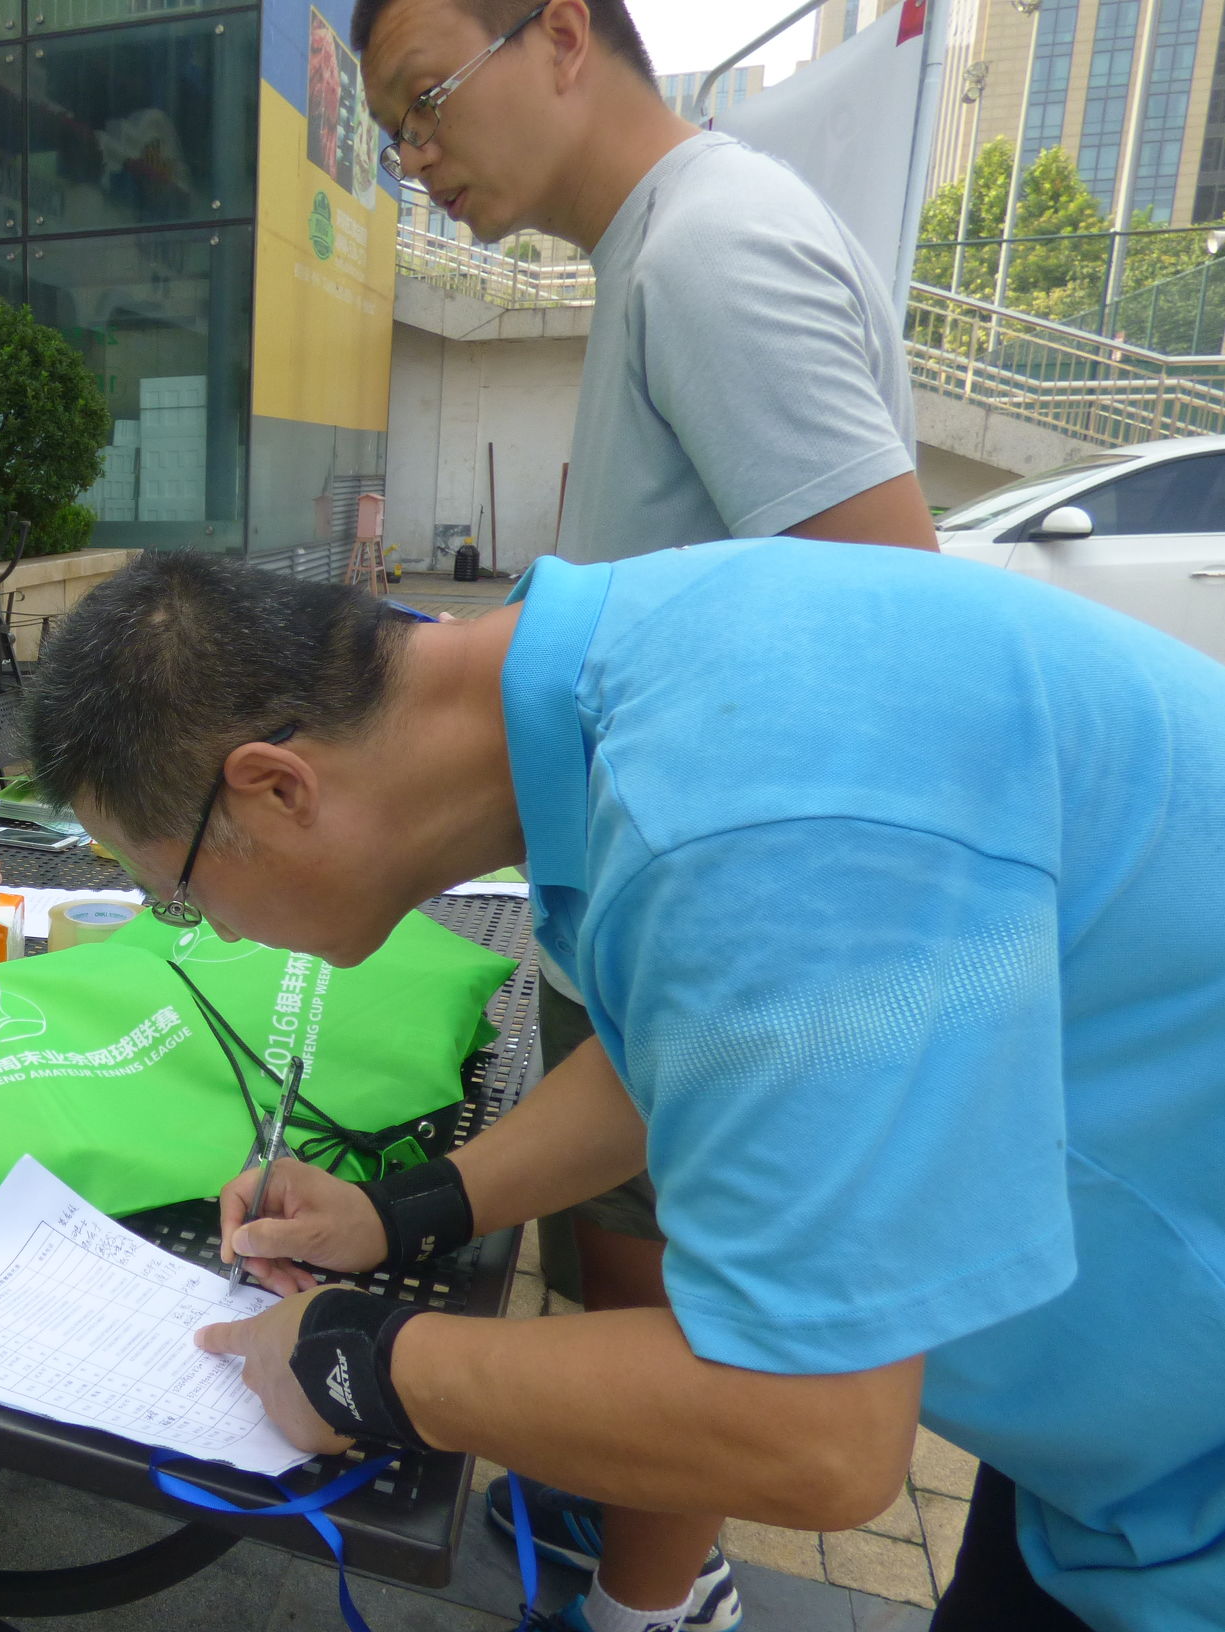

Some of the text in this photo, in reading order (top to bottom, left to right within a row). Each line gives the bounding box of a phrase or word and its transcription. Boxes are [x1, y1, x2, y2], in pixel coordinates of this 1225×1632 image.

[261, 952, 314, 1080] 2016银丰杯
[308, 997, 325, 1022] CUP
[29, 1068, 93, 1080] AMATEUR
[94, 1062, 144, 1079] TENNIS
[145, 1026, 194, 1067] LEAGUE
